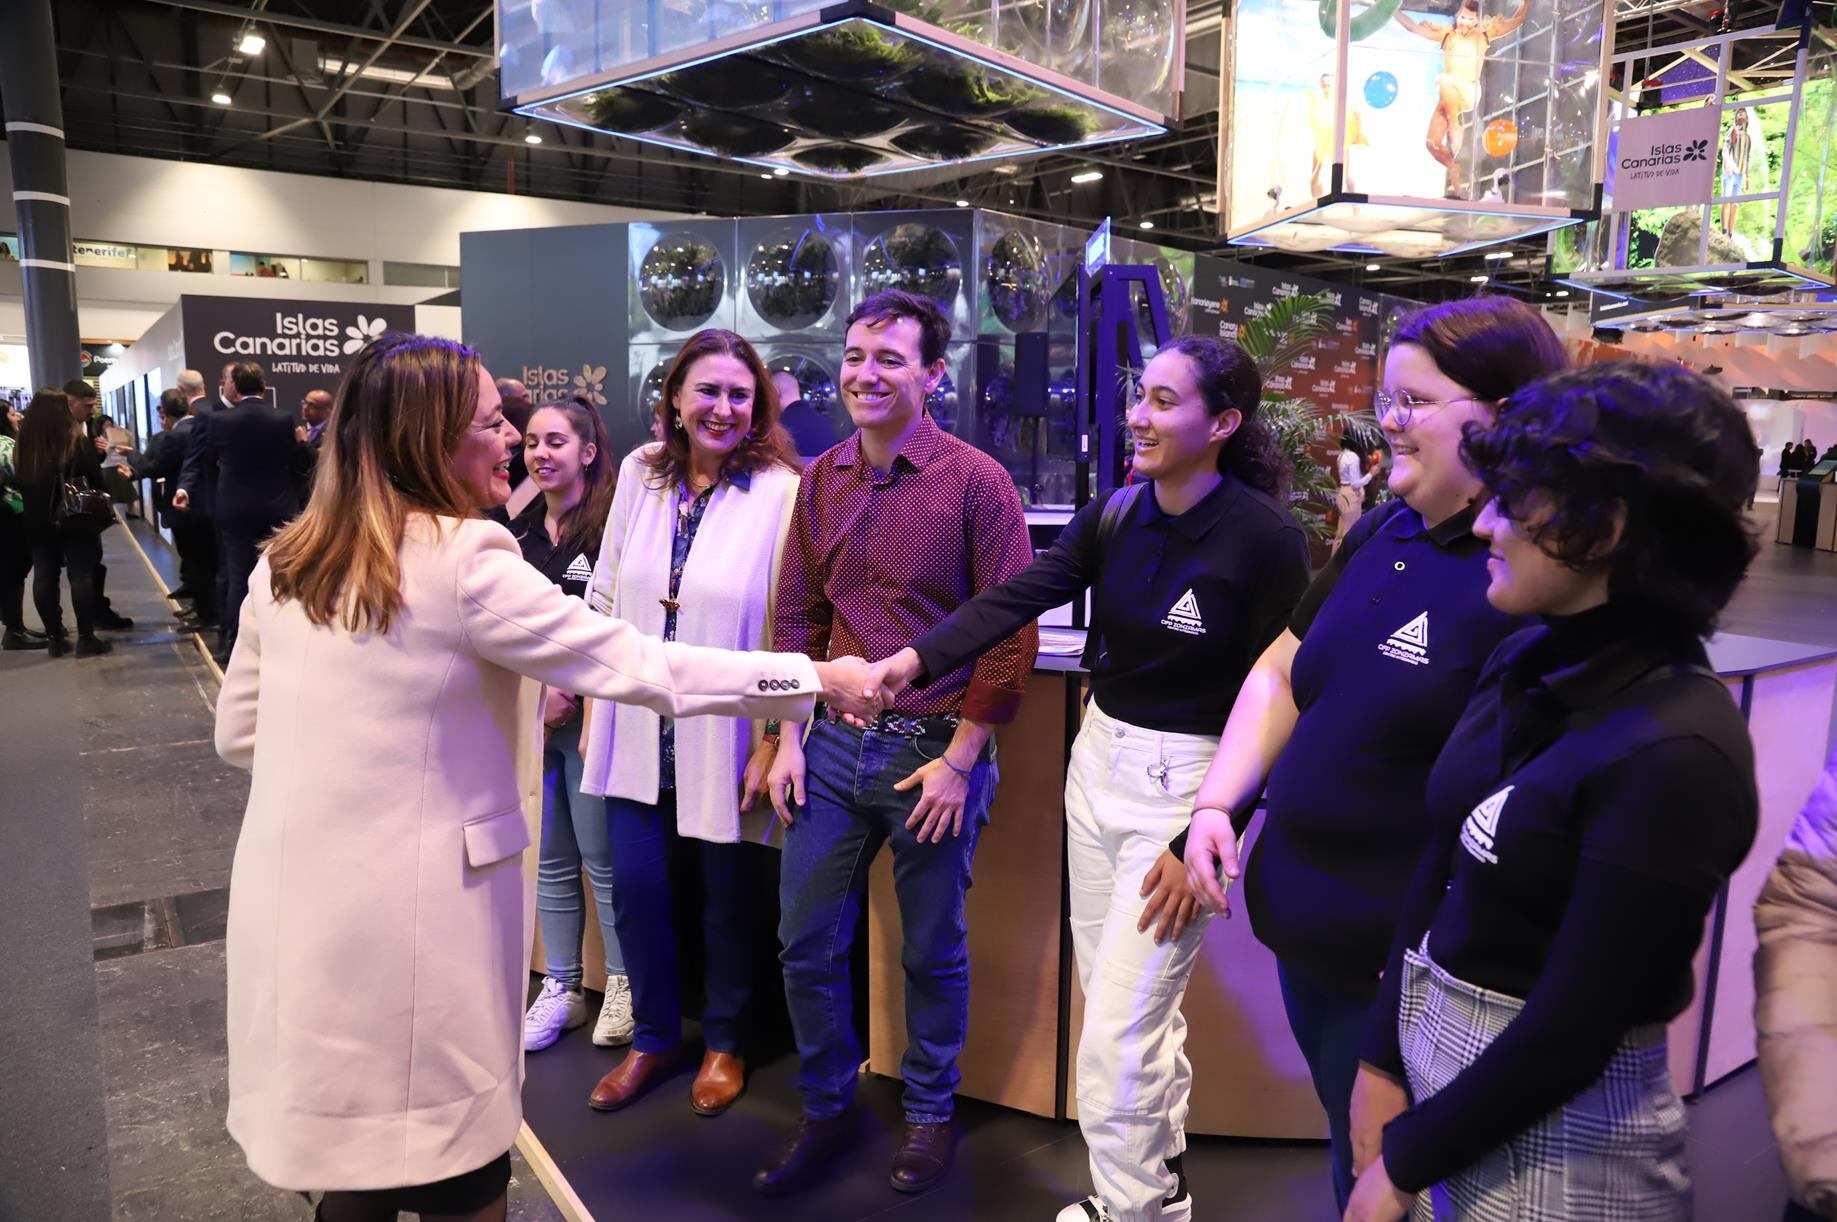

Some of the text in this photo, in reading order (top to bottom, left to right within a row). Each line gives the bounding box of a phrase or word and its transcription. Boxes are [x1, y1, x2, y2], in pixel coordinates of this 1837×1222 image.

[1651, 144, 1682, 156] Islas
[1621, 154, 1681, 169] Canarias
[275, 312, 340, 336] Islas
[213, 331, 341, 357] Canarias
[308, 363, 320, 374] DE
[321, 364, 341, 374] VIDA
[522, 366, 570, 386] Islas
